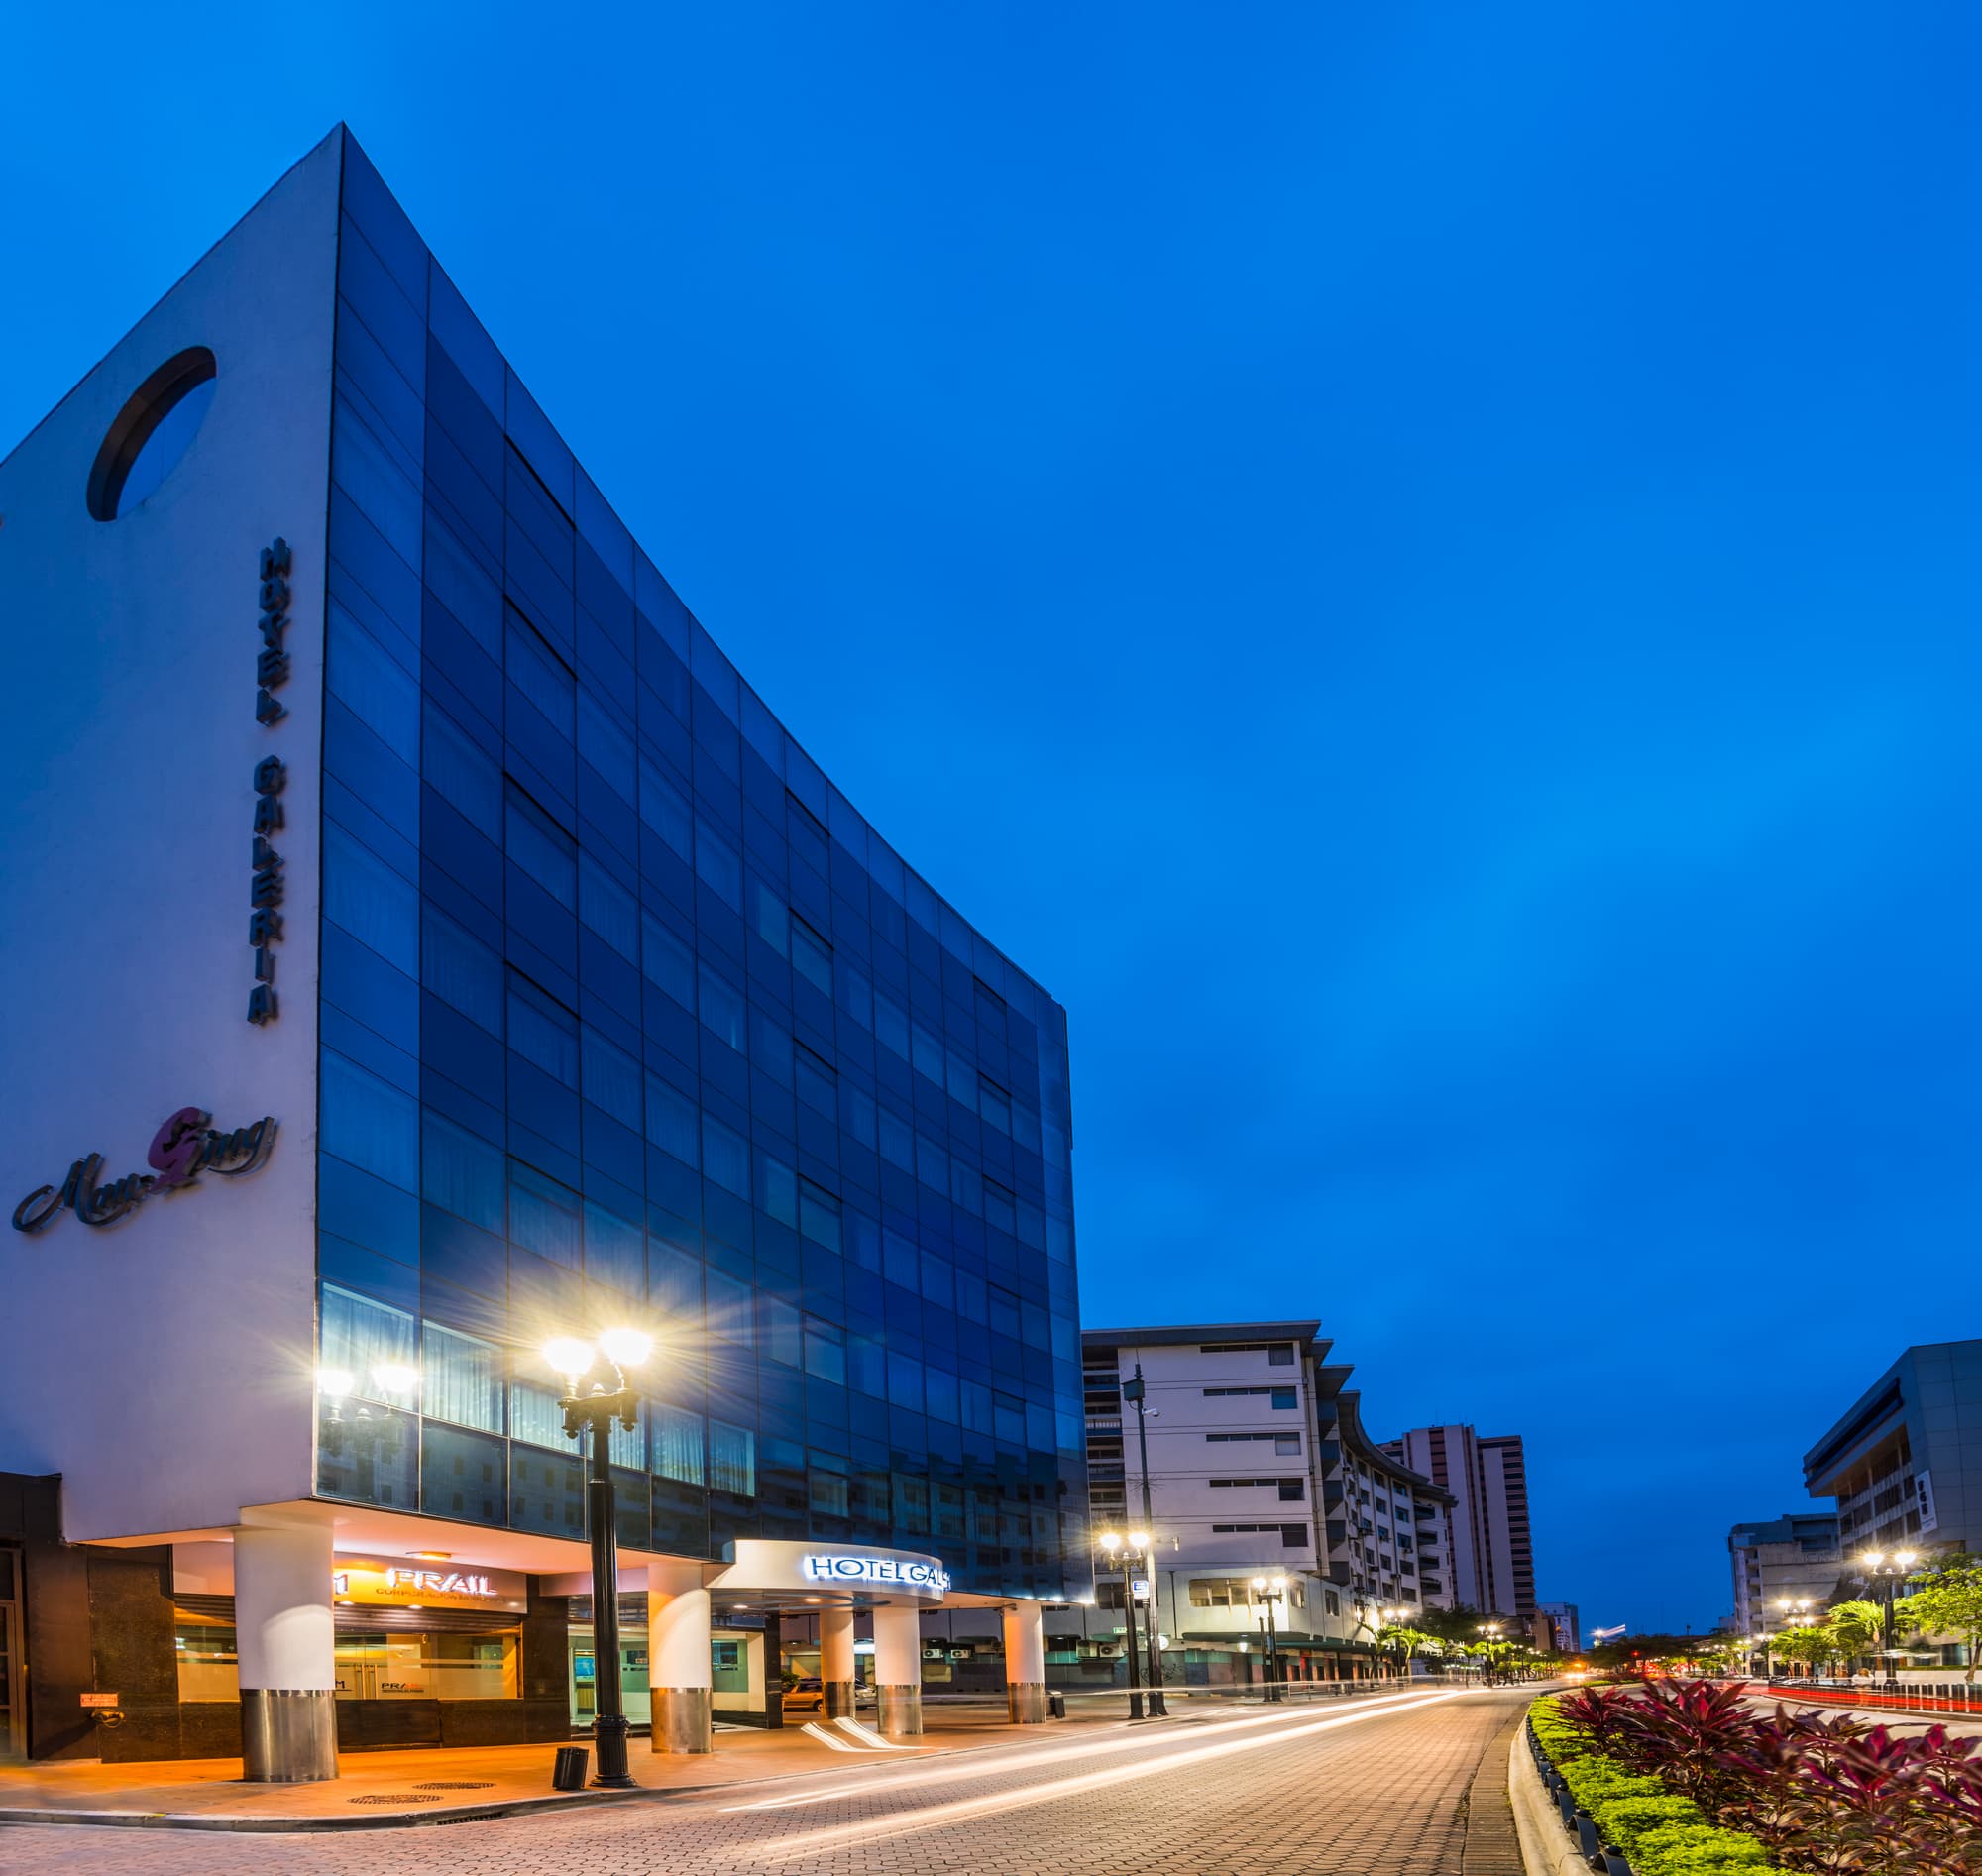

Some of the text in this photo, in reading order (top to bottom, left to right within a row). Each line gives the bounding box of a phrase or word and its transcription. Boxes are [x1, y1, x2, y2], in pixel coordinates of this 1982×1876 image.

[247, 536, 291, 1025] HOTEL GALERIA
[811, 1558, 904, 1580] HOTEL
